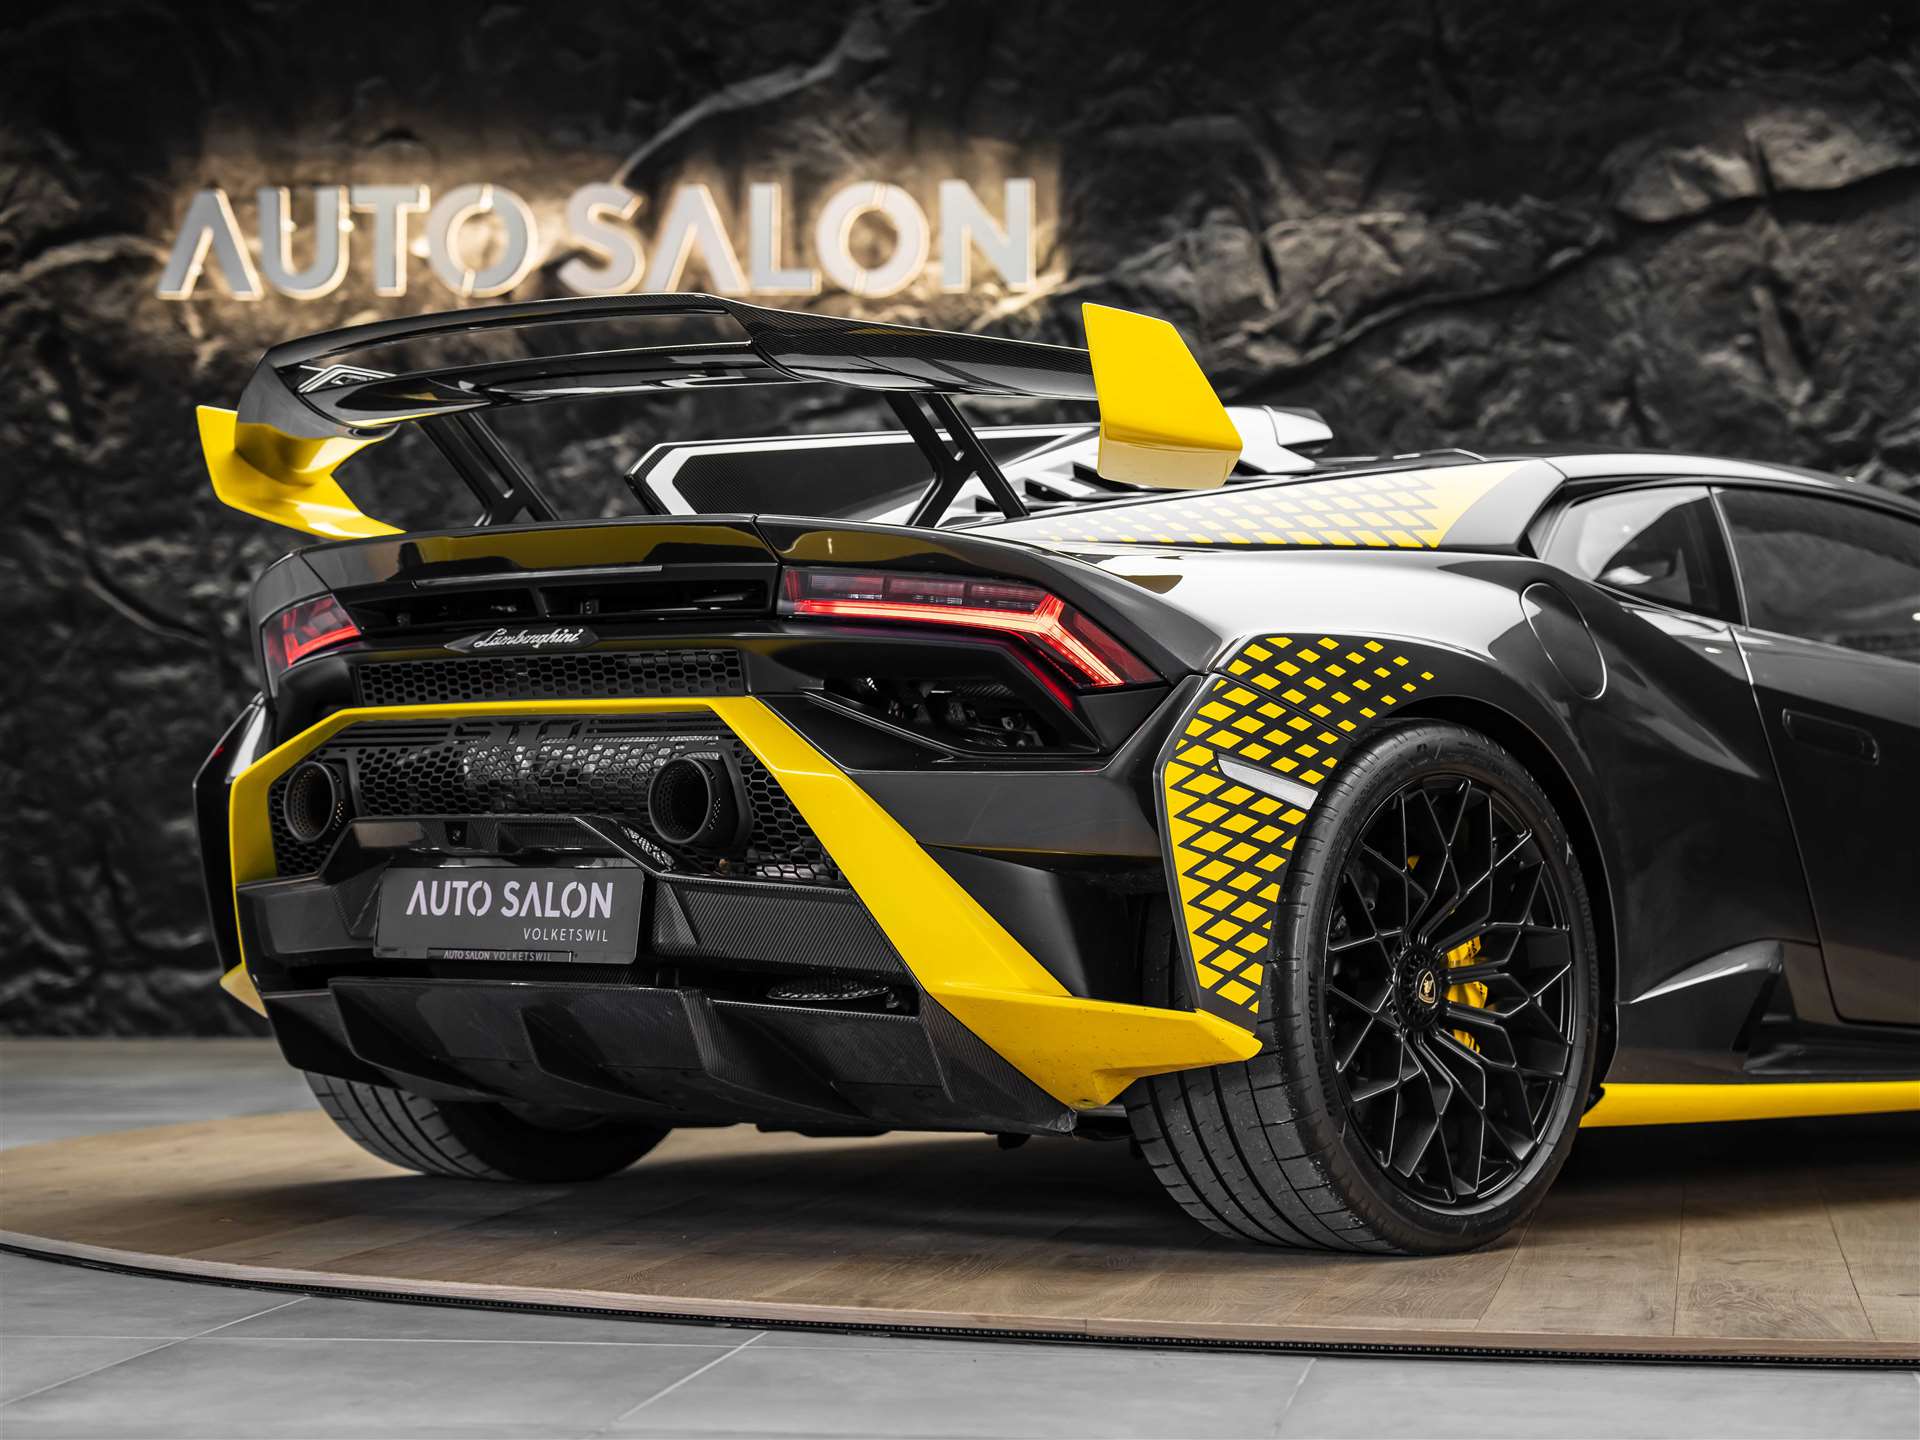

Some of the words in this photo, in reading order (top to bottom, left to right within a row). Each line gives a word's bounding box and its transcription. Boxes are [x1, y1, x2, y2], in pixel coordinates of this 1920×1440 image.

[157, 184, 539, 300] AUTO
[557, 178, 1036, 298] SALON
[473, 628, 584, 648] Lamborghini
[406, 880, 492, 916] AUTO
[501, 881, 613, 918] SALON
[523, 928, 608, 942] VOLKETSWIL
[444, 951, 463, 960] AUTO
[465, 951, 490, 961] SALON
[494, 952, 551, 961] VOLKETSWIL
